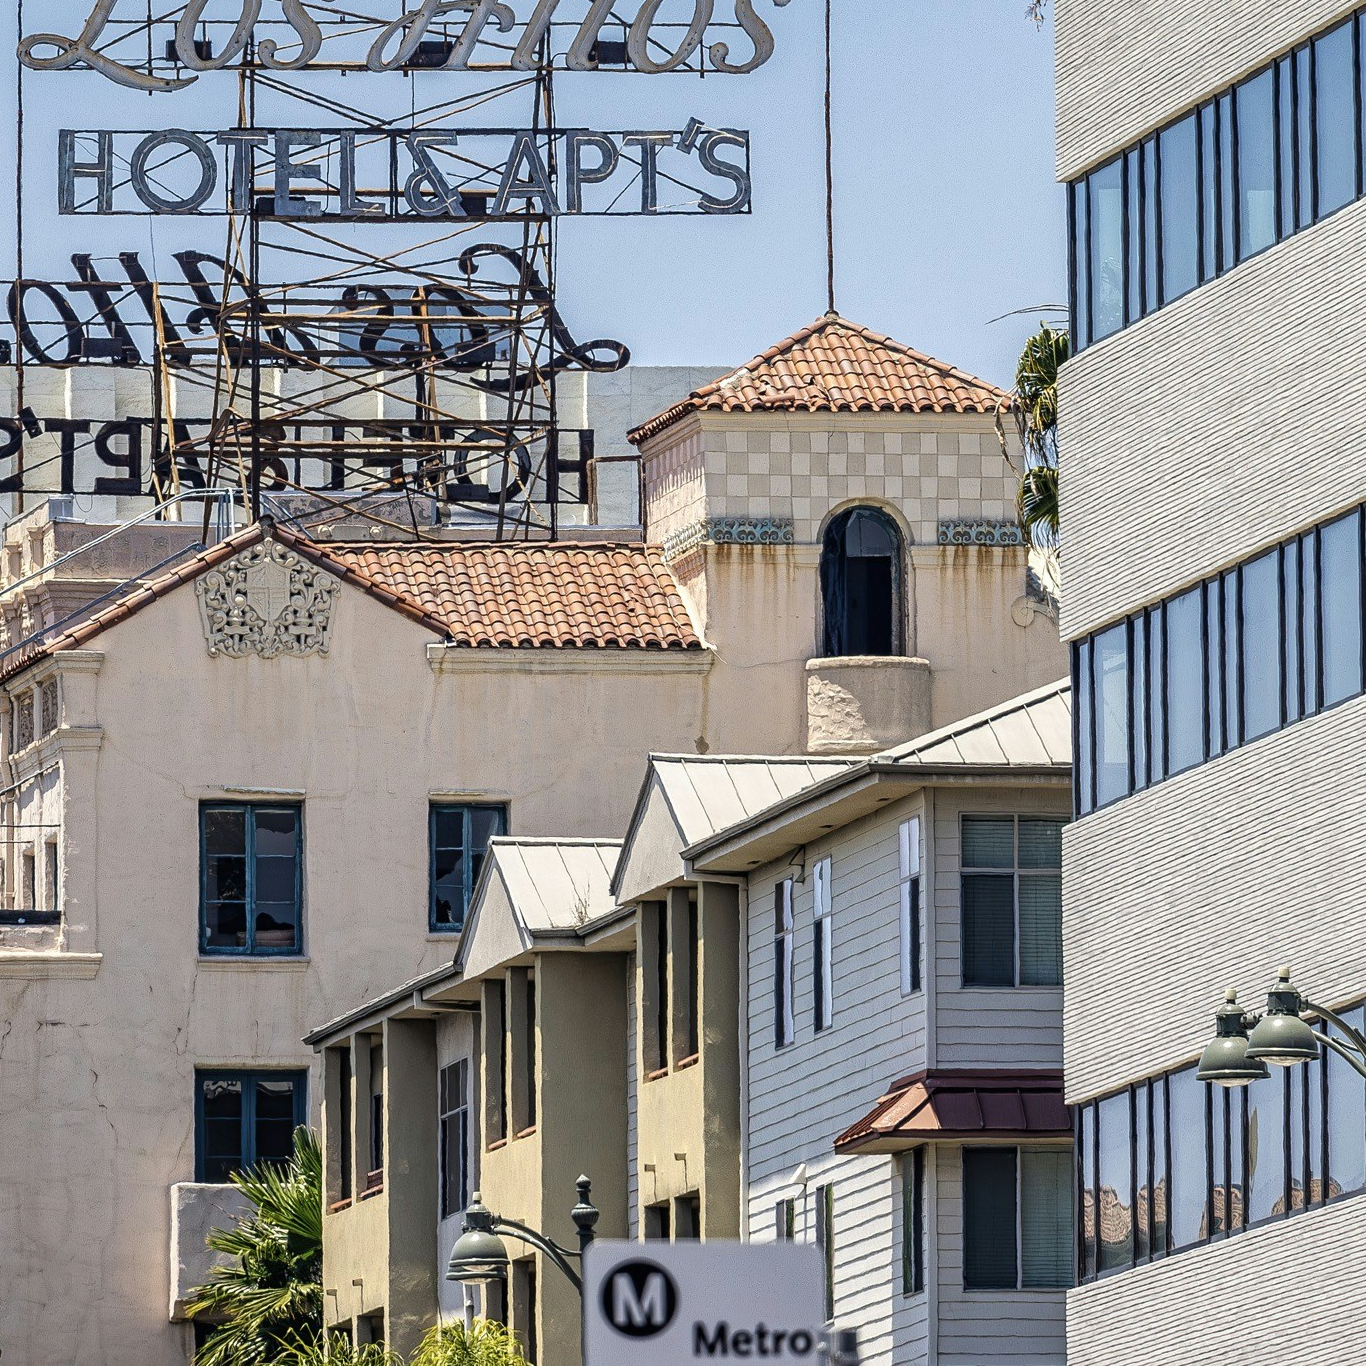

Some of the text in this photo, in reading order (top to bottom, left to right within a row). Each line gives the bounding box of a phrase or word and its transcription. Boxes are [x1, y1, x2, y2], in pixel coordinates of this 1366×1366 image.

[58, 116, 751, 216] HOTEL & APT'S
[612, 1272, 668, 1327] M
[692, 1320, 813, 1357] Metro
